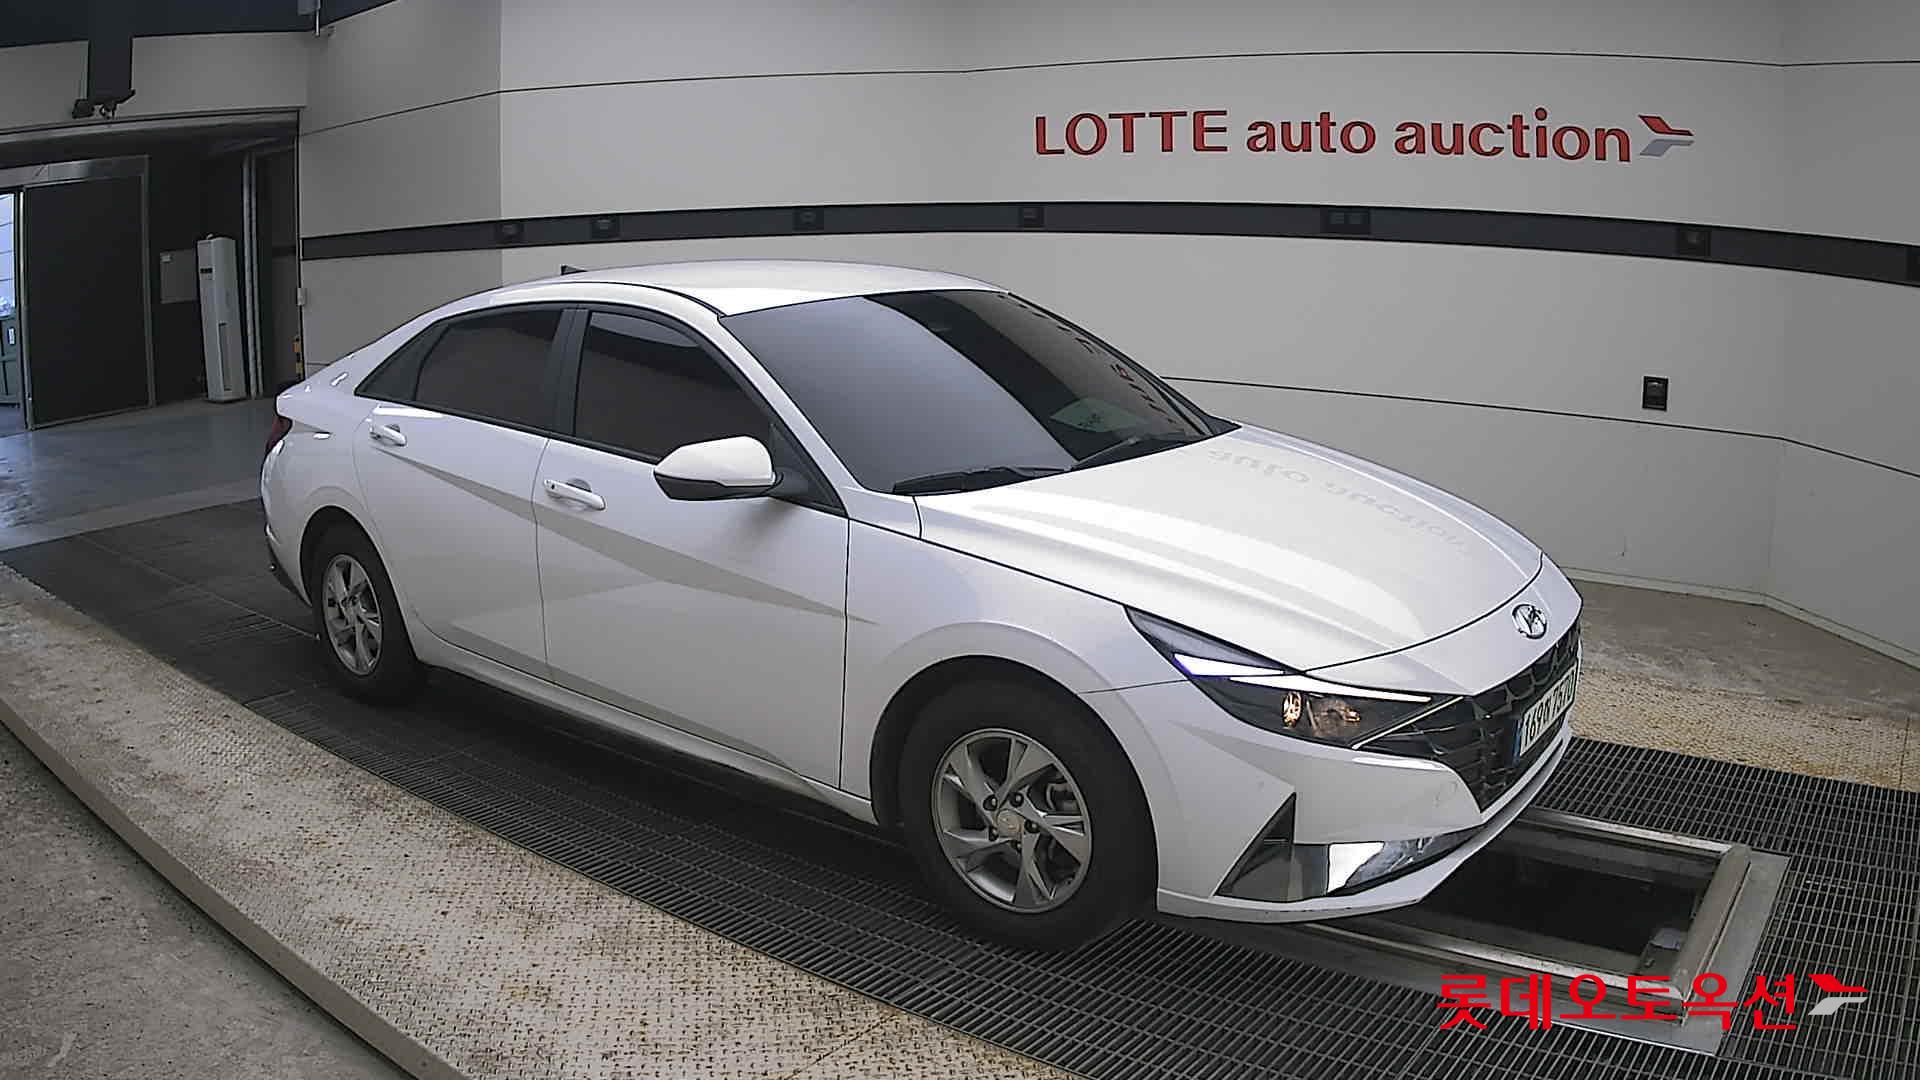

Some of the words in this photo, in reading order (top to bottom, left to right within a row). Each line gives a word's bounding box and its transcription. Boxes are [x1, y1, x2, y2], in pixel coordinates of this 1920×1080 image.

[1036, 110, 1228, 155] LOTTE
[1246, 111, 1377, 153] auto
[1394, 107, 1631, 162] auction
